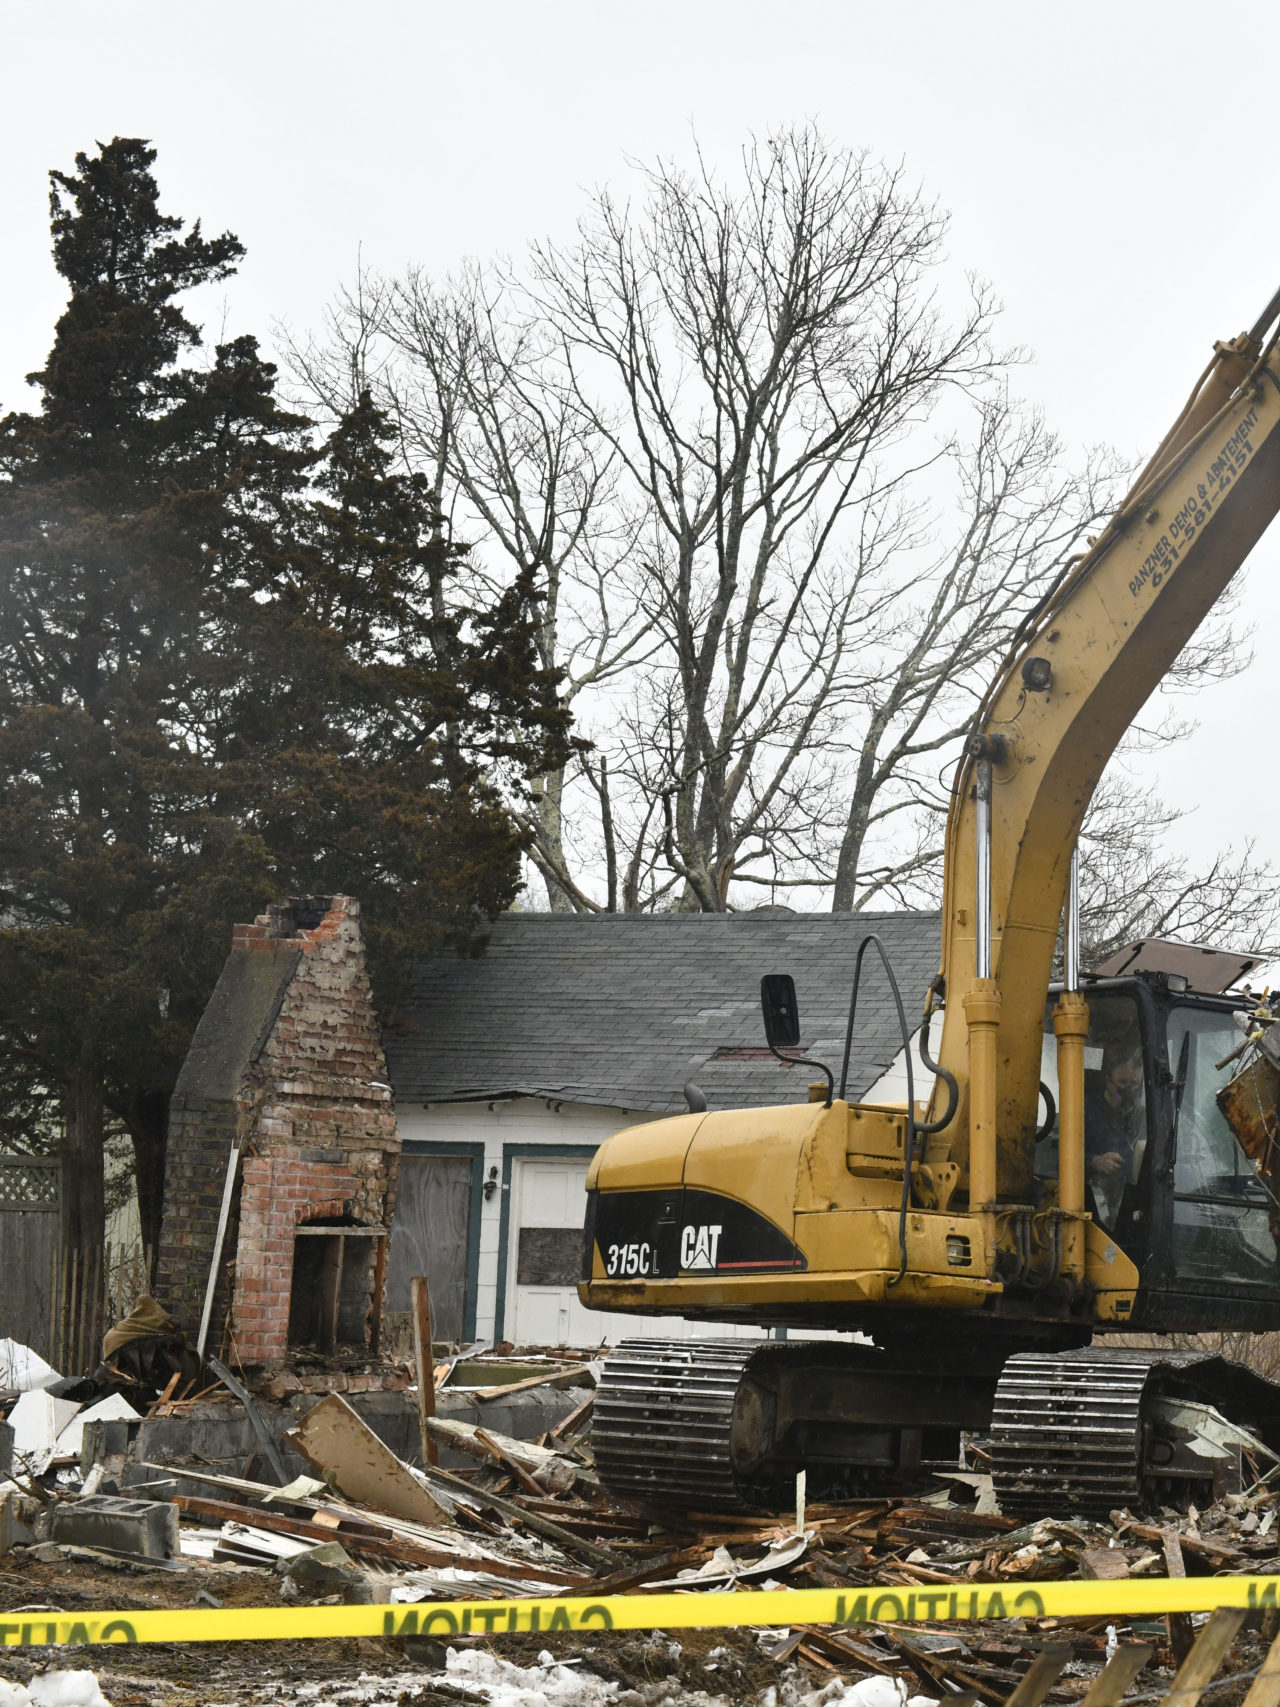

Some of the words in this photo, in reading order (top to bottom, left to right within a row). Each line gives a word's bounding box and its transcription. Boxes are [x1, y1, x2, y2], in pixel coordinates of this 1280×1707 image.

[1128, 535, 1171, 597] PANZNER
[1168, 496, 1198, 540] DEMO
[1196, 483, 1208, 500] &
[1206, 407, 1259, 488] ABATEMENT
[1151, 439, 1254, 588] 631-581-4151
[607, 1242, 650, 1275] 315C
[680, 1225, 722, 1269] CAT
